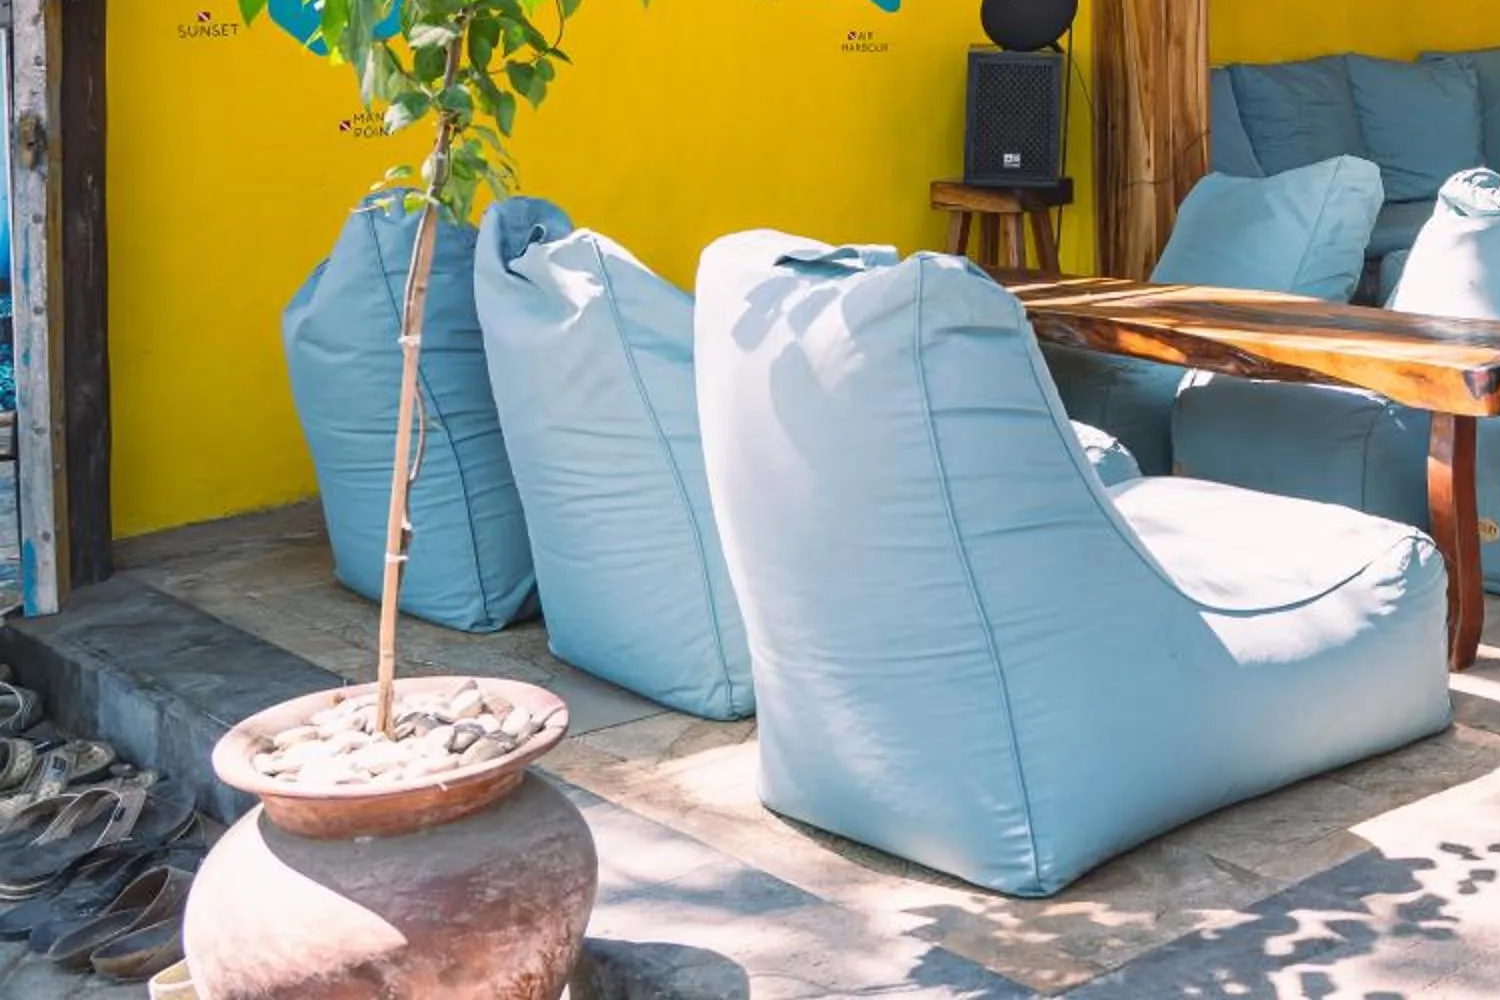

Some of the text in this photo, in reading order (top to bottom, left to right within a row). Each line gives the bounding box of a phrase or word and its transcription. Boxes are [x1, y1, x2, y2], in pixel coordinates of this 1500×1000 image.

[177, 23, 239, 39] SUNSET
[841, 42, 890, 53] HARBOUR
[353, 125, 394, 138] POIN
